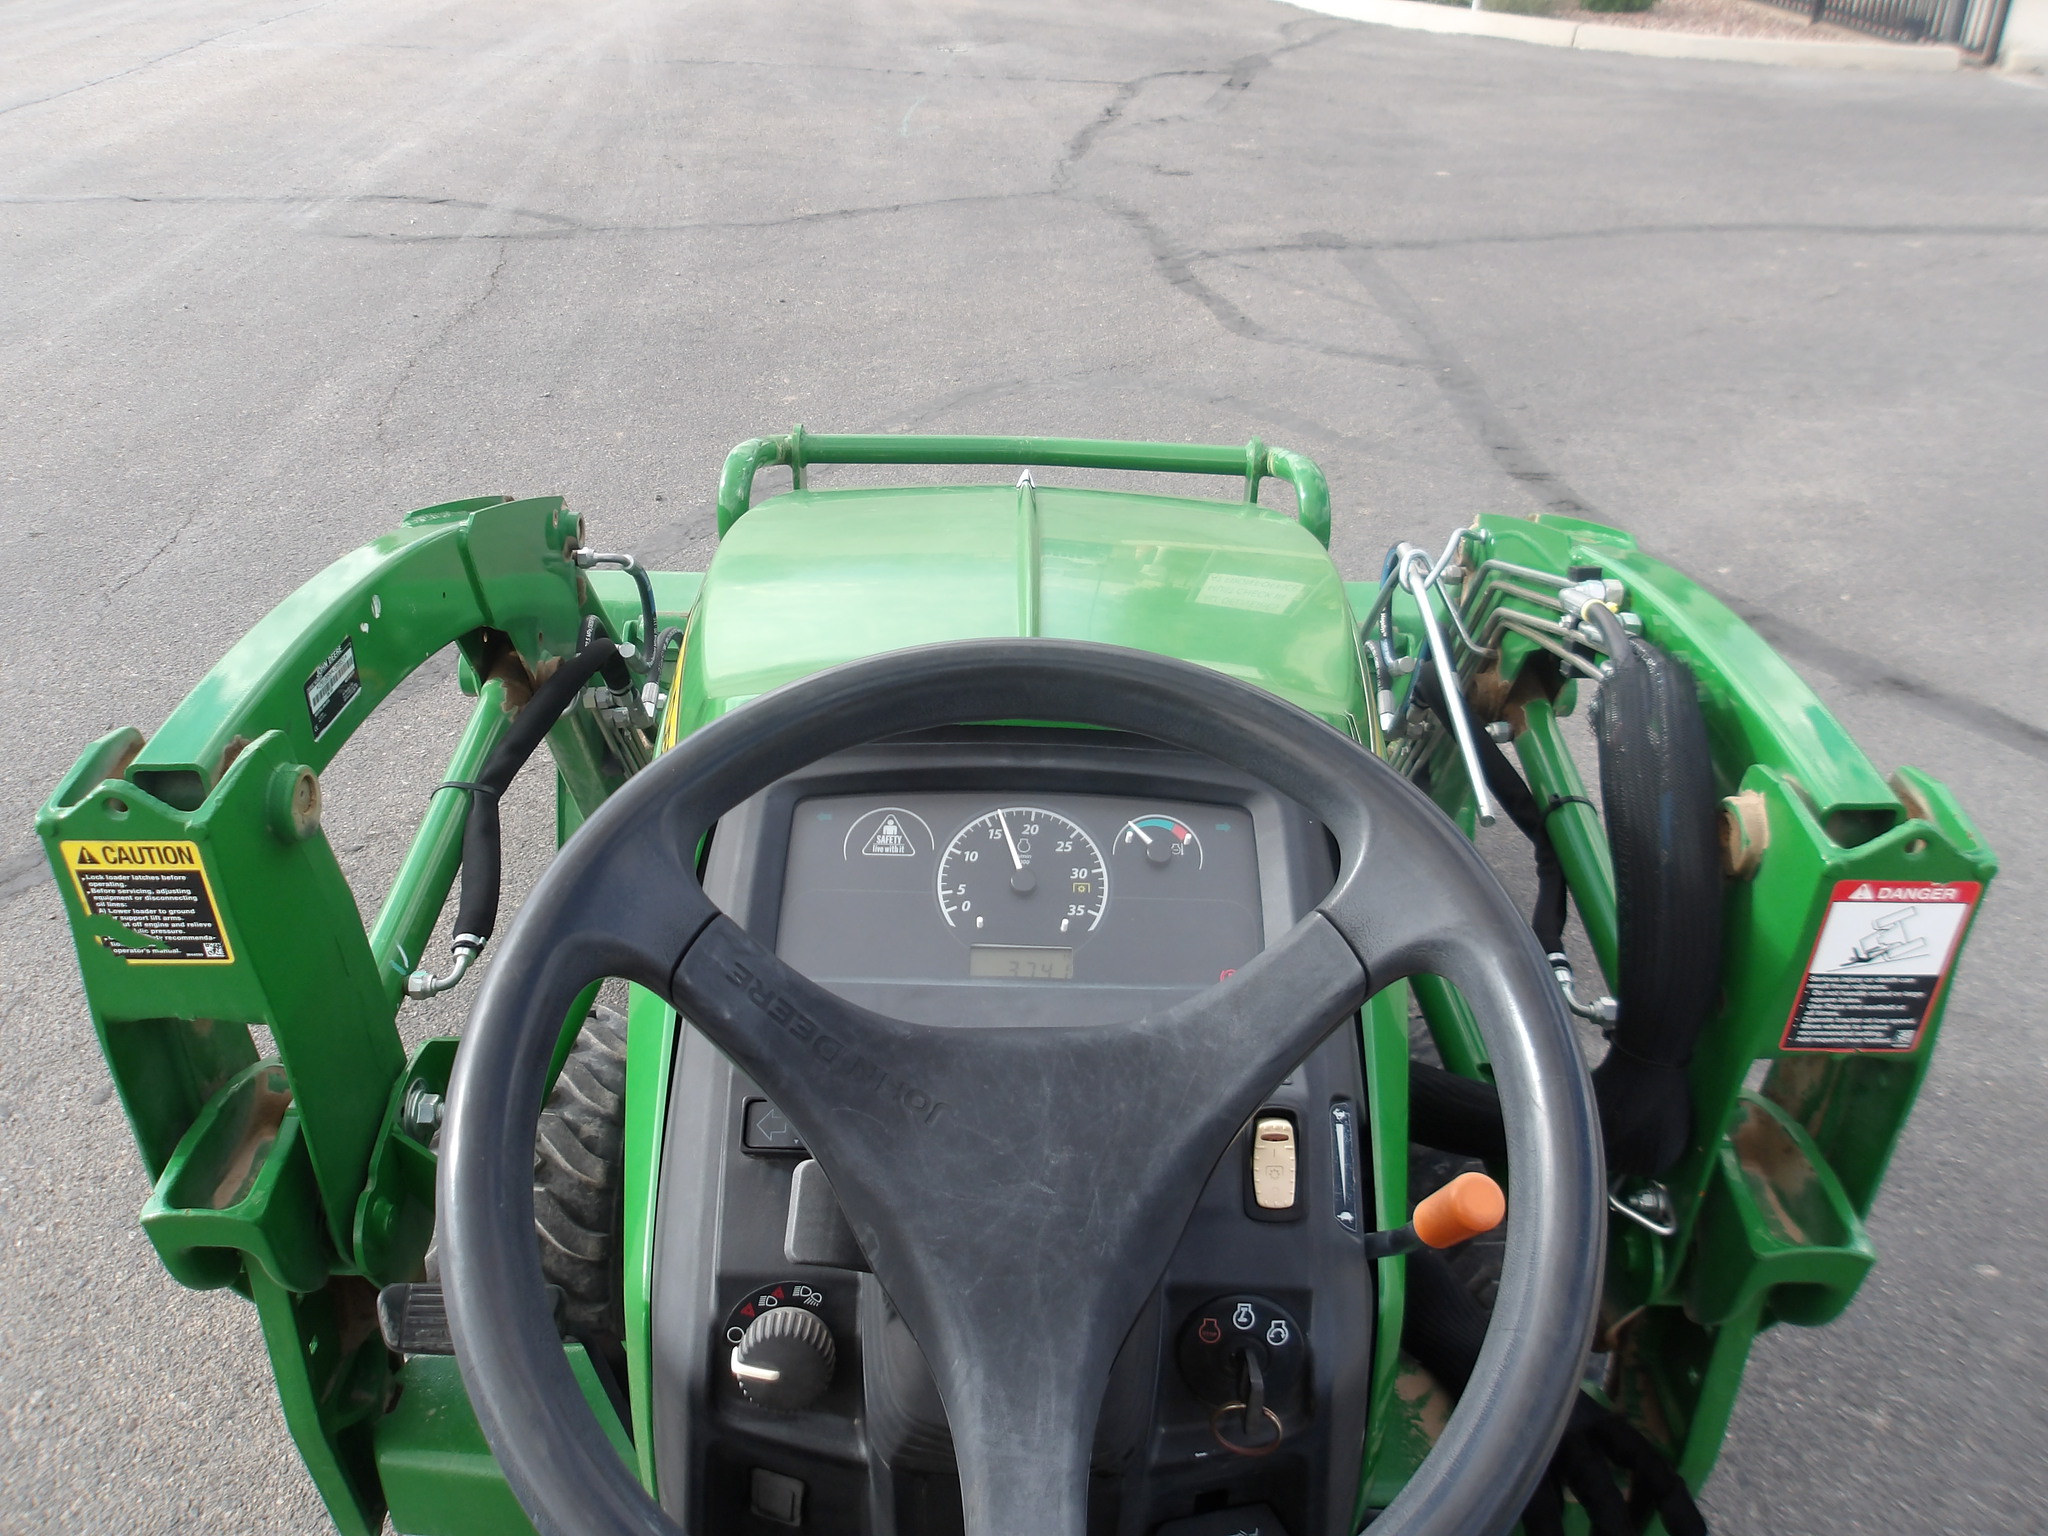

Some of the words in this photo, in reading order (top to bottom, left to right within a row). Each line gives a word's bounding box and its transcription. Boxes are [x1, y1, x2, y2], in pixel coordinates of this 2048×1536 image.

[988, 828, 1002, 839] 15
[1021, 824, 1039, 835] 20
[875, 835, 902, 844] SAFETY
[1055, 841, 1073, 852] 25
[101, 846, 195, 864] CAUTION
[964, 851, 978, 862] 10
[1070, 868, 1088, 879] 30
[957, 884, 966, 895] 5
[1877, 887, 1958, 900] DANGER
[961, 900, 971, 912] 0
[1068, 904, 1085, 915] 35
[725, 961, 849, 1063] DEERE
